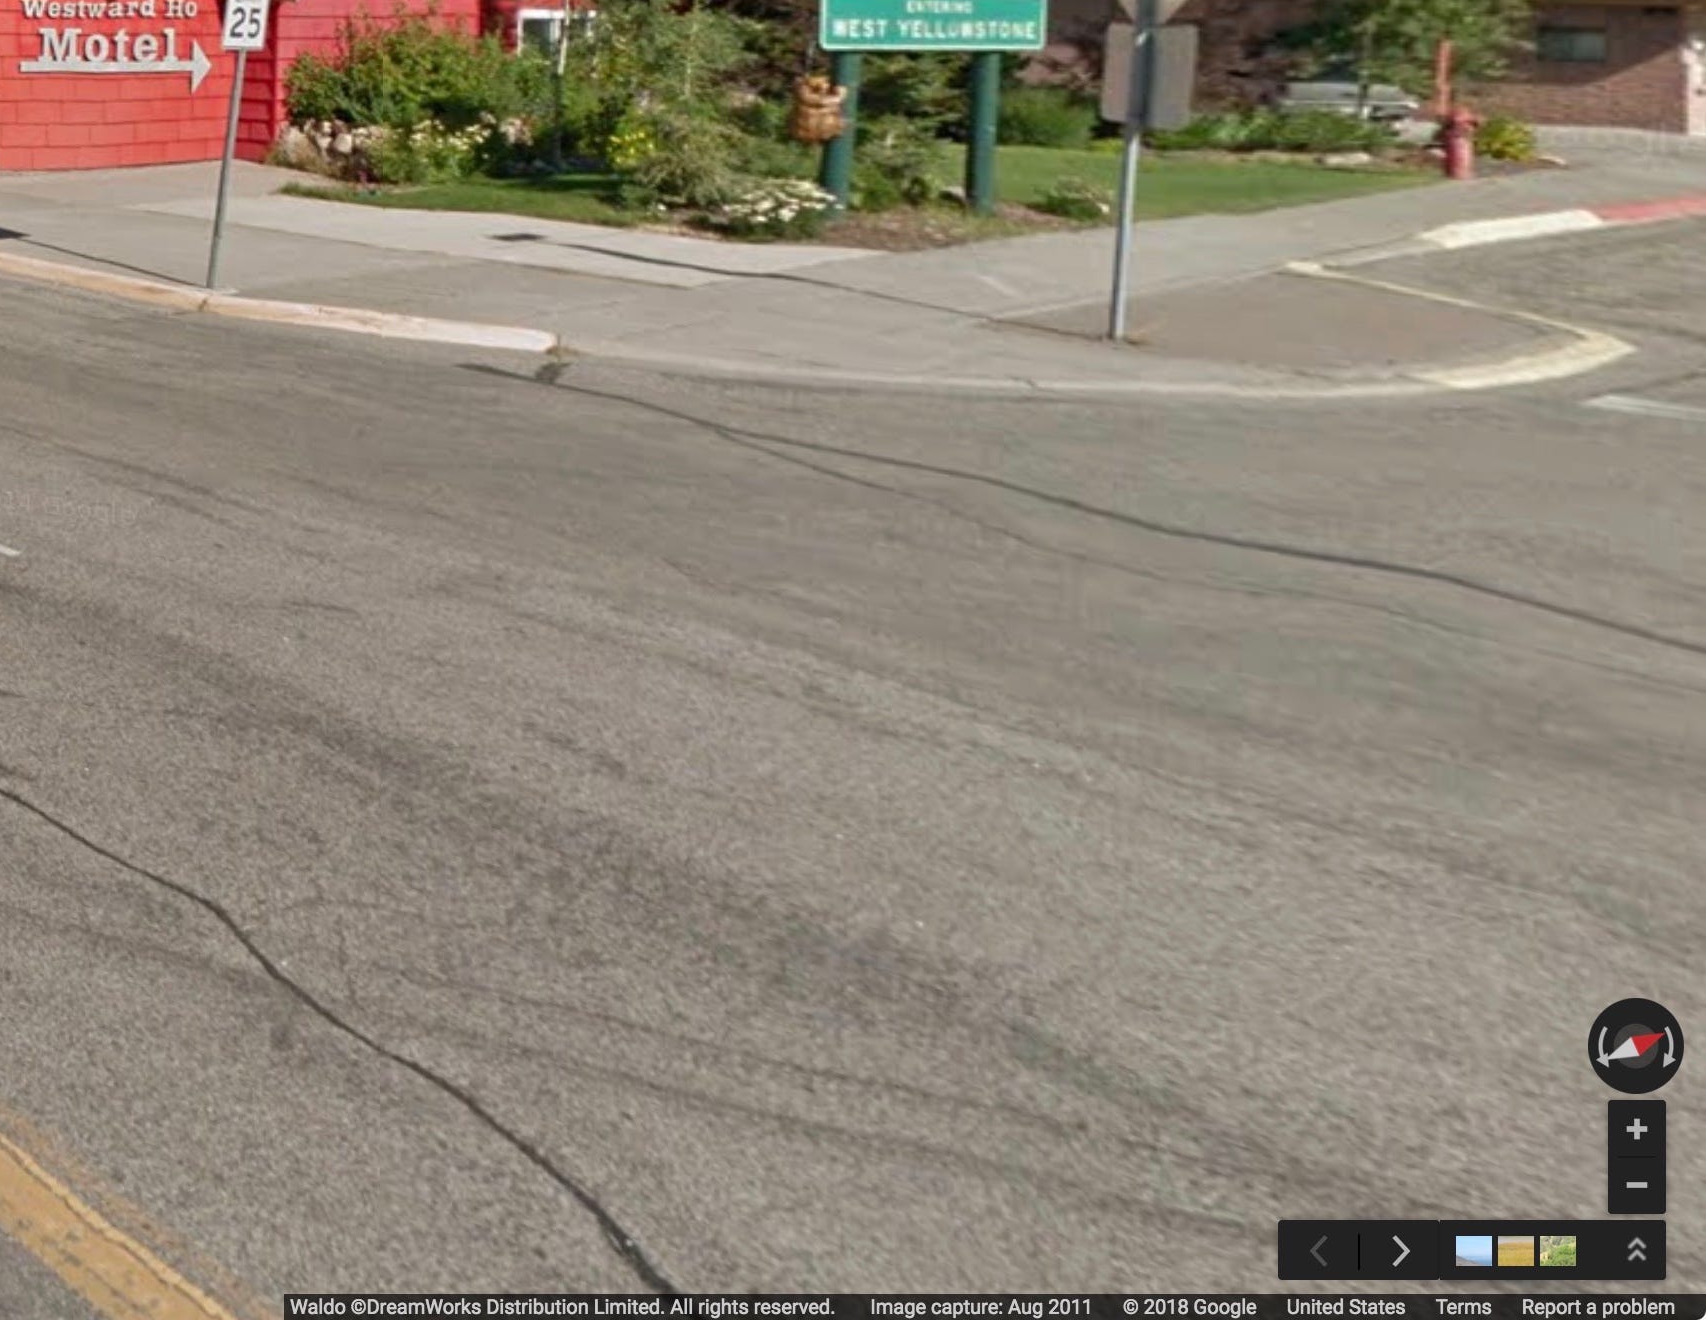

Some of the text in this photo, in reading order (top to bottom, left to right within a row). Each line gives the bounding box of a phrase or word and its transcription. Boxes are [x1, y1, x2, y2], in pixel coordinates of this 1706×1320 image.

[905, 0, 974, 14] ENTERING
[229, 7, 262, 40] 25
[831, 18, 1037, 40] WEST YELLOWSTONE
[38, 26, 180, 64] Motel
